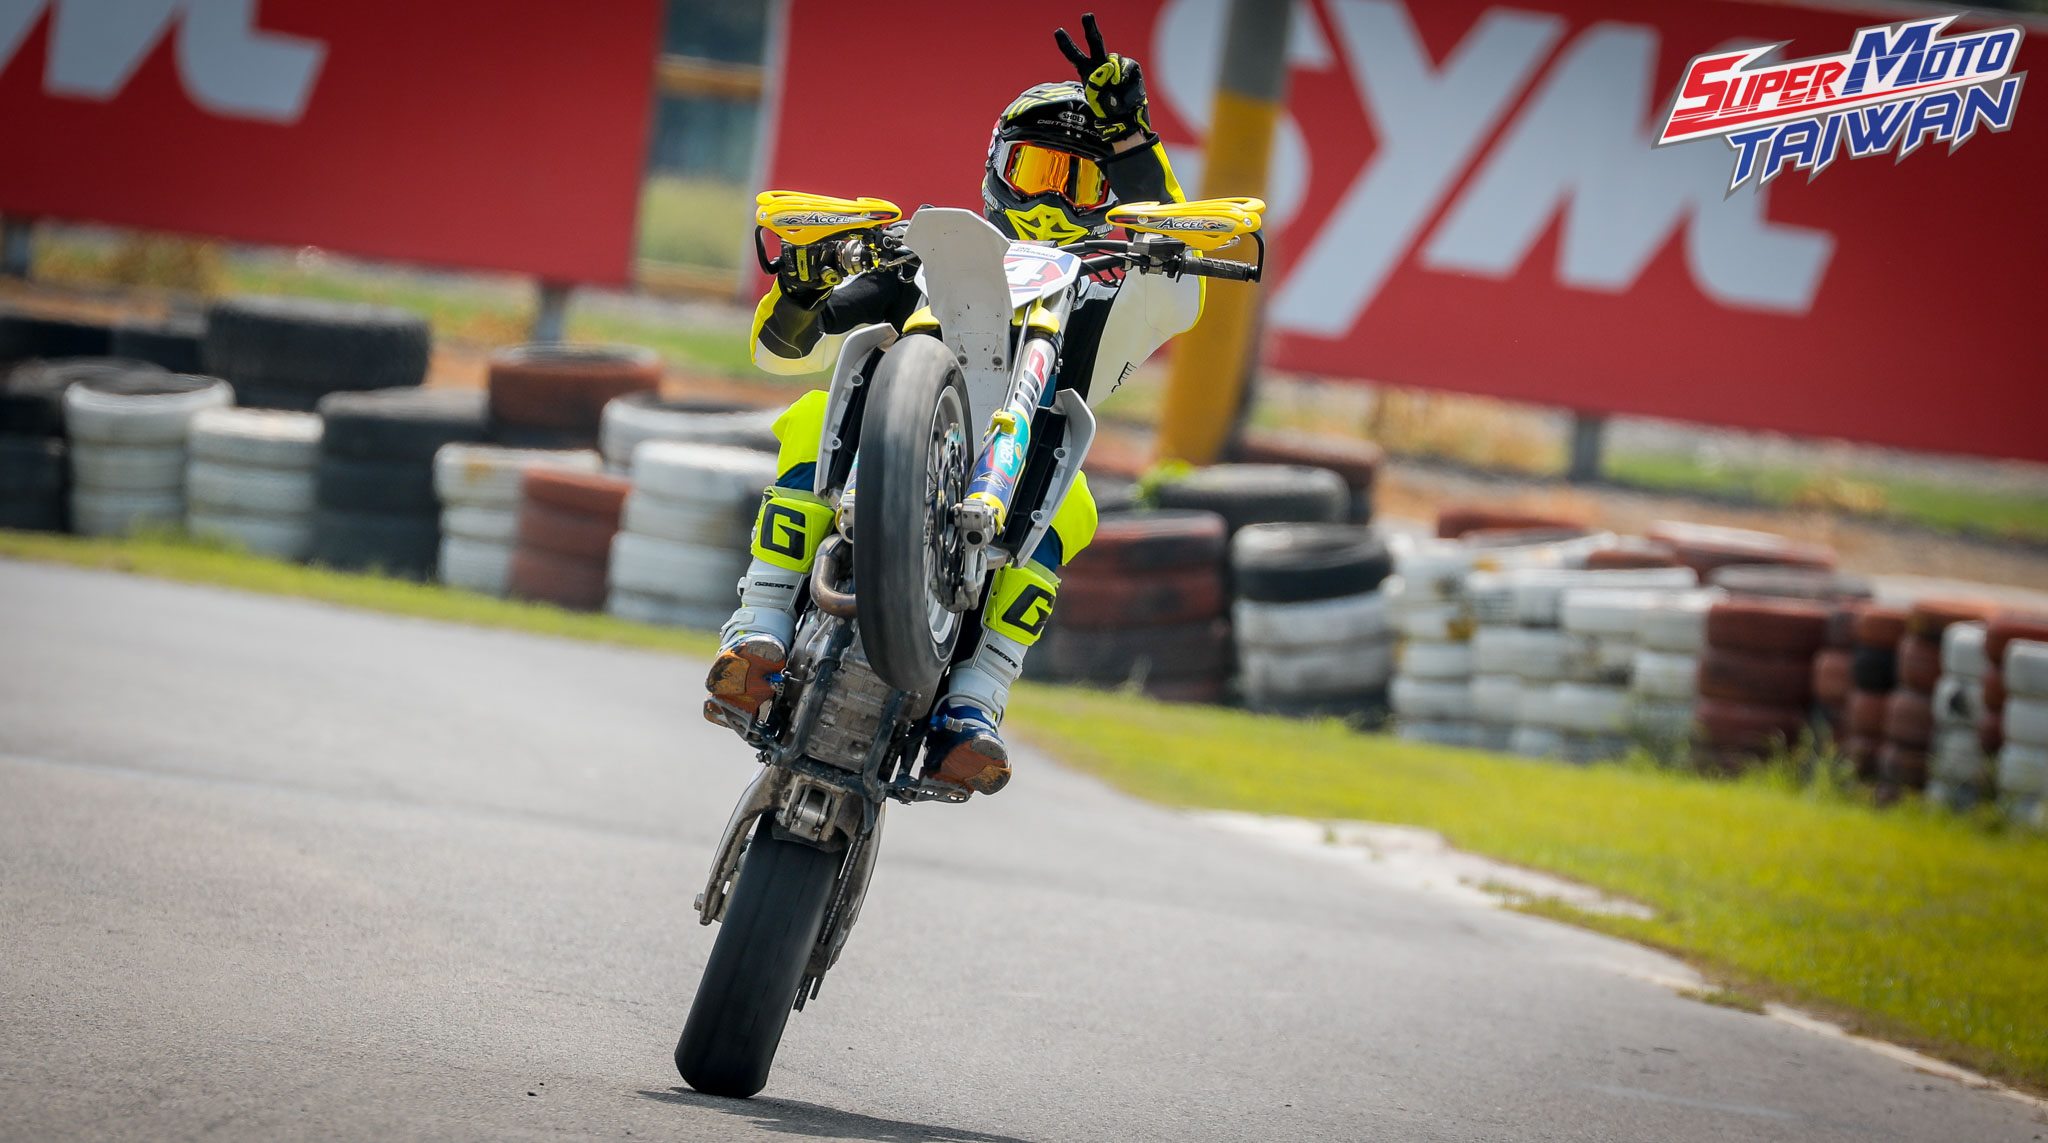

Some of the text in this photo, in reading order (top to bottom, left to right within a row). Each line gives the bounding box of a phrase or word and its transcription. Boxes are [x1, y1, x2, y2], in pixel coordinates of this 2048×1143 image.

[804, 212, 850, 225] ACCEL
[1157, 216, 1204, 230] ACCEL
[760, 503, 806, 561] G
[1002, 584, 1056, 636] G
